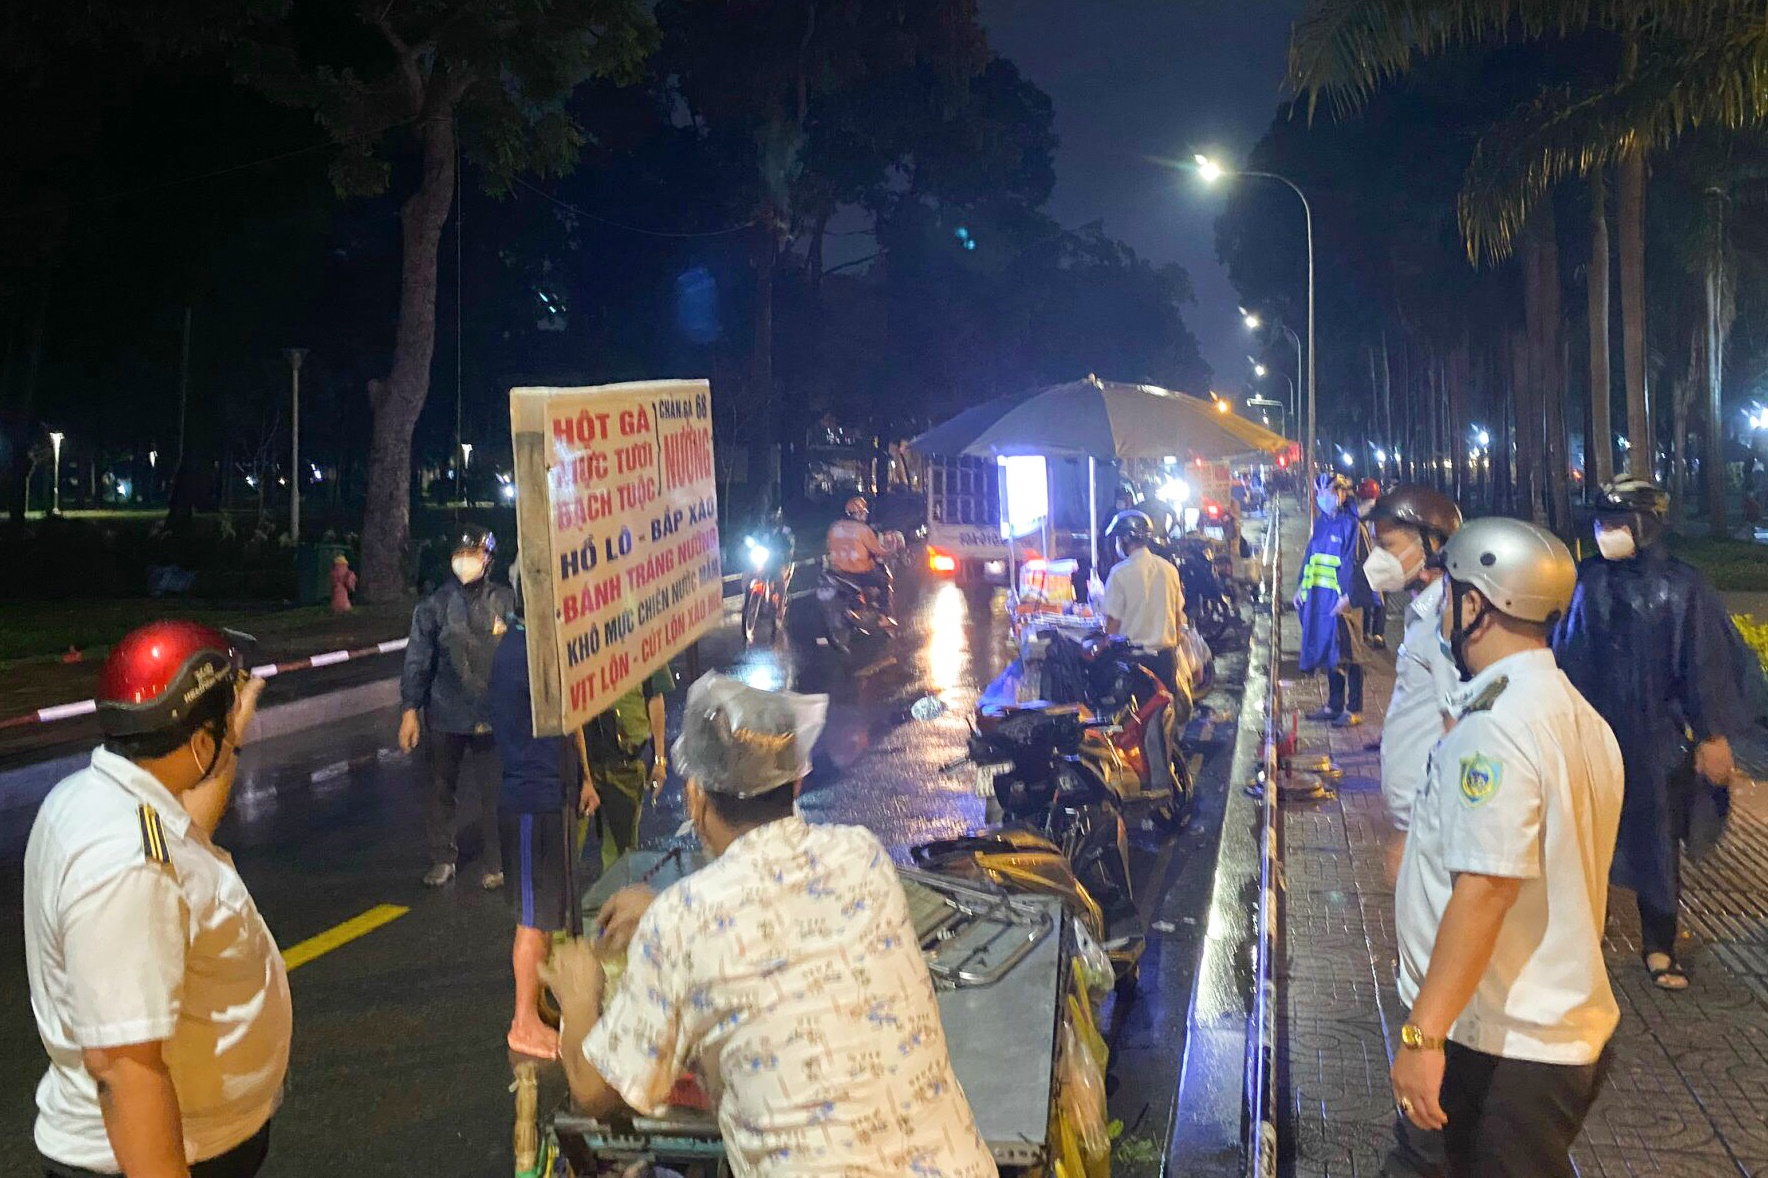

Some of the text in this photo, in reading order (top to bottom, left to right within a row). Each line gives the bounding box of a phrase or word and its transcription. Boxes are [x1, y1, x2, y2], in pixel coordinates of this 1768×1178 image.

[553, 403, 650, 449] HỘT GÀ
[695, 393, 708, 420] 68
[663, 420, 712, 491] NƯỚNG
[557, 475, 655, 532] BẠCH TUỘC
[605, 526, 632, 562] LÔ
[688, 496, 715, 526] XÀO
[562, 574, 622, 625] BÁNH
[626, 553, 675, 592] TRÁNG
[566, 621, 601, 668] KHÔ
[569, 671, 597, 713] VỊT
[601, 651, 630, 691] LỘN
